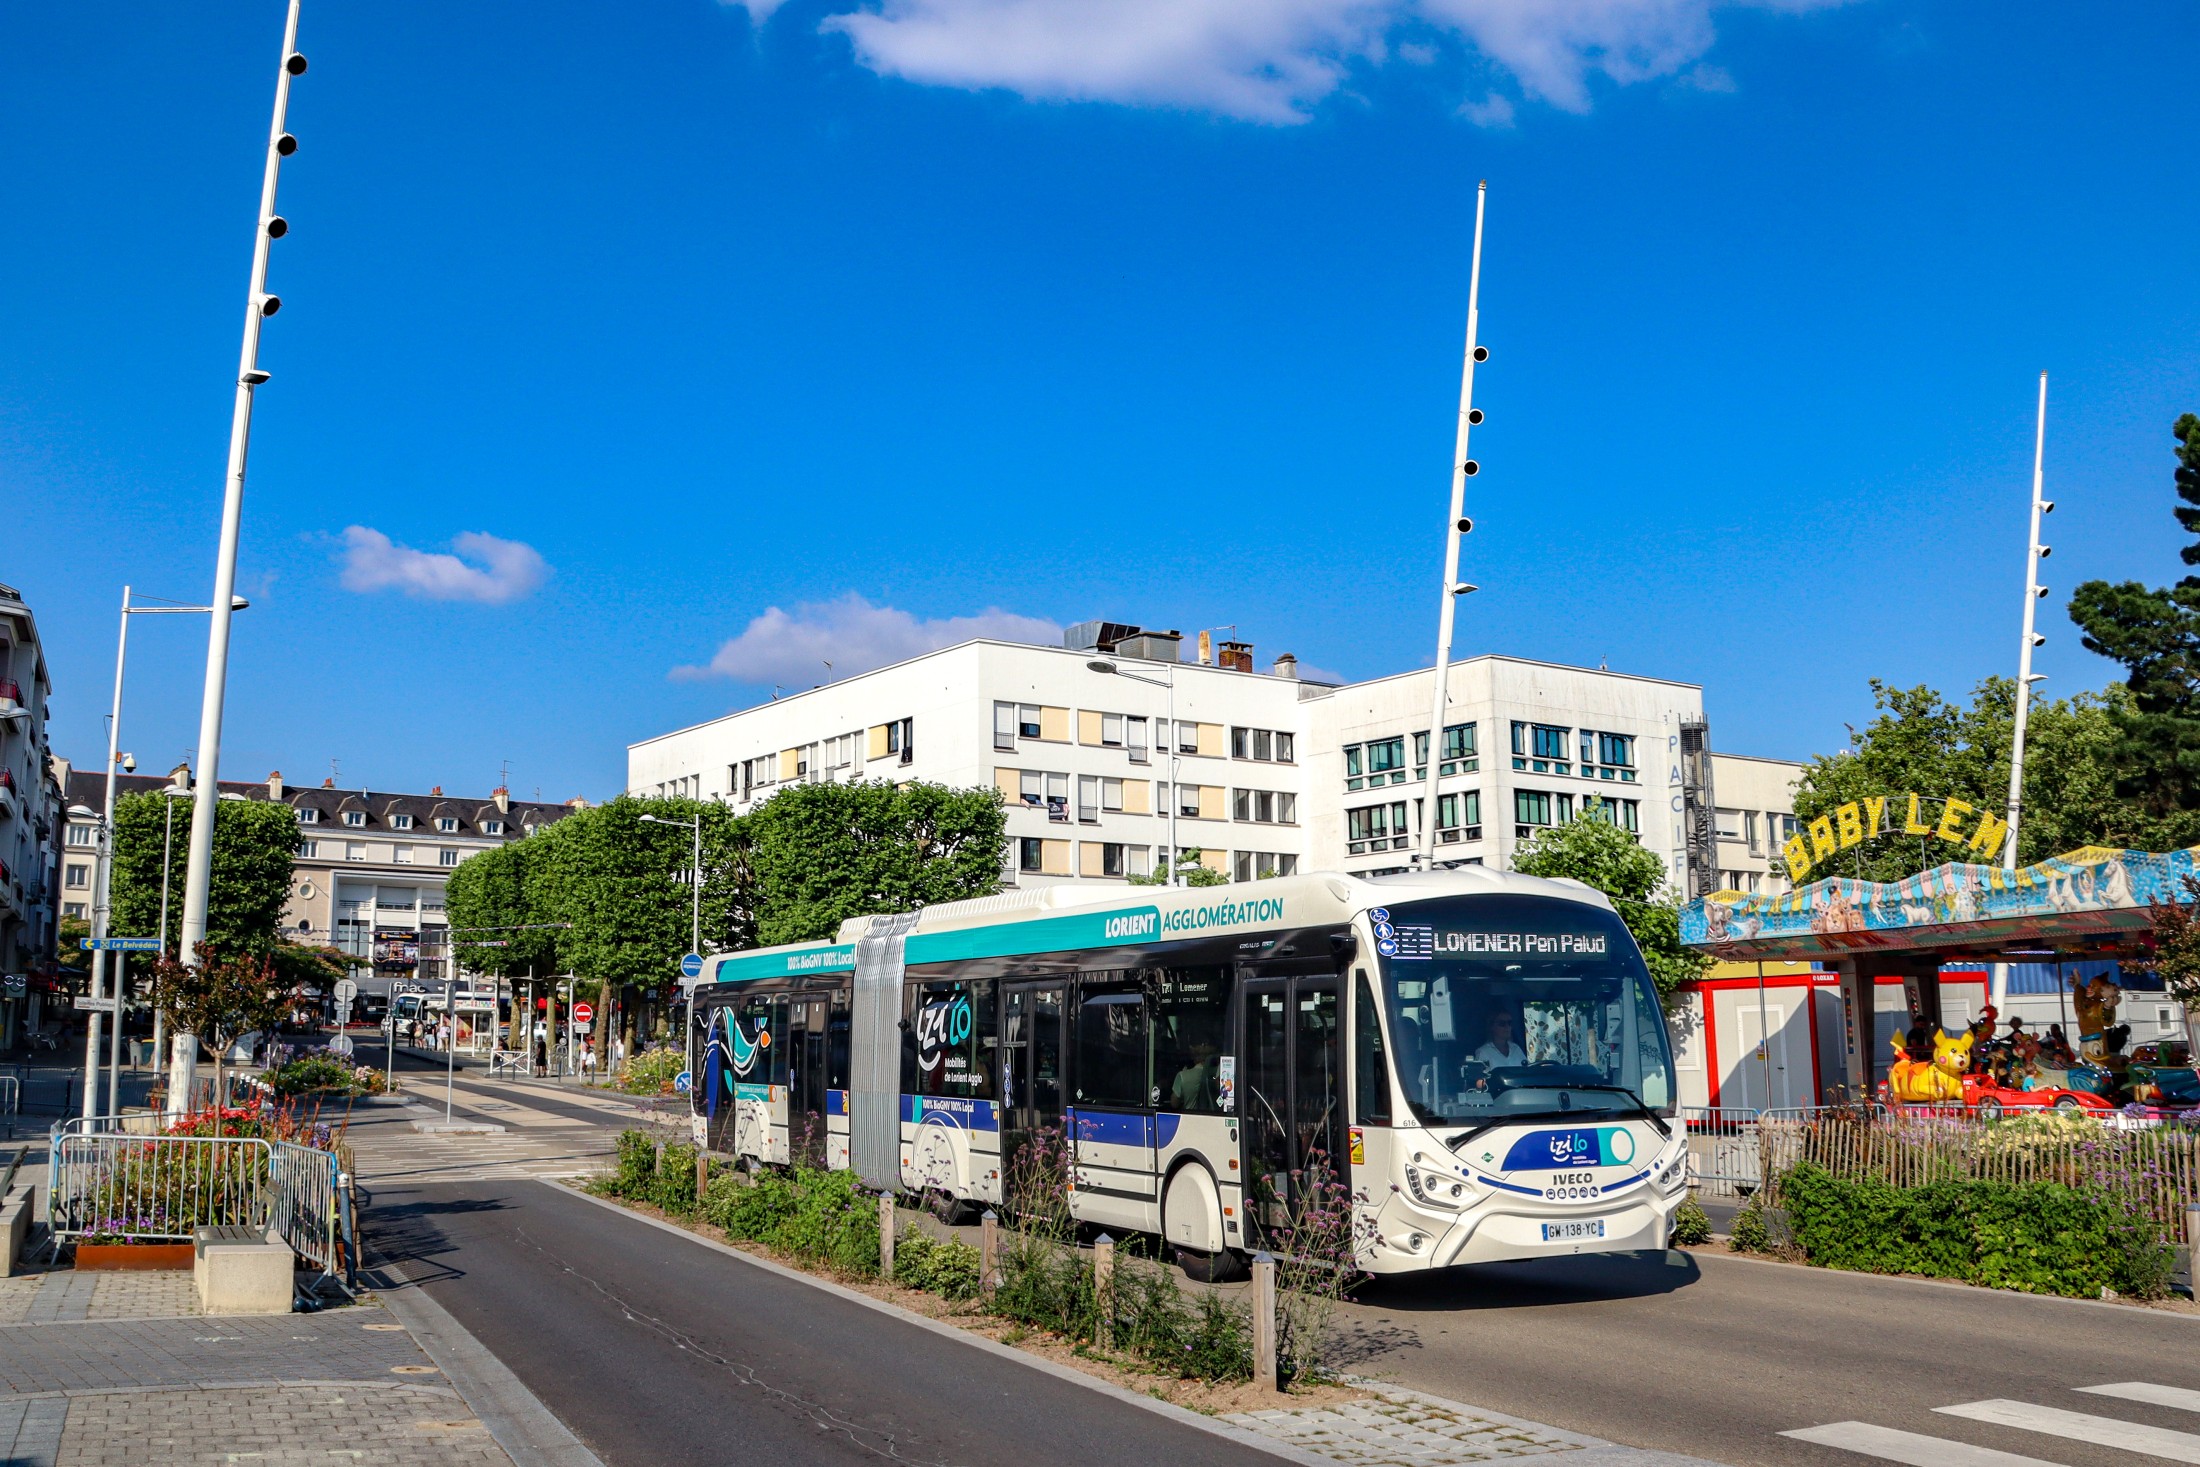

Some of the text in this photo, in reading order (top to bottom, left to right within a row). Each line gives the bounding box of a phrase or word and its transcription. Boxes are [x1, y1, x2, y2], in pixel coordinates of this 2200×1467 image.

[1669, 735, 1685, 899] PACIF
[1783, 792, 2009, 883] BABY LEM
[1105, 897, 1284, 939] LORIENT AGGLOMÉRATION
[112, 941, 159, 949] Le Belvédère
[1434, 932, 1522, 952] LOMENER
[1525, 934, 1558, 953] Pen
[1561, 934, 1606, 953] Palud
[787, 948, 854, 970] 100% BioGNV 100% Local
[393, 981, 426, 993] fnac
[1180, 982, 1208, 992] Lomener
[944, 1056, 966, 1068] Mobilités
[944, 1071, 982, 1086] de Lorient Agglo
[962, 1101, 974, 1112] Local
[1553, 1173, 1593, 1185] IVECO
[1548, 1223, 1598, 1238] GW-138-YC
